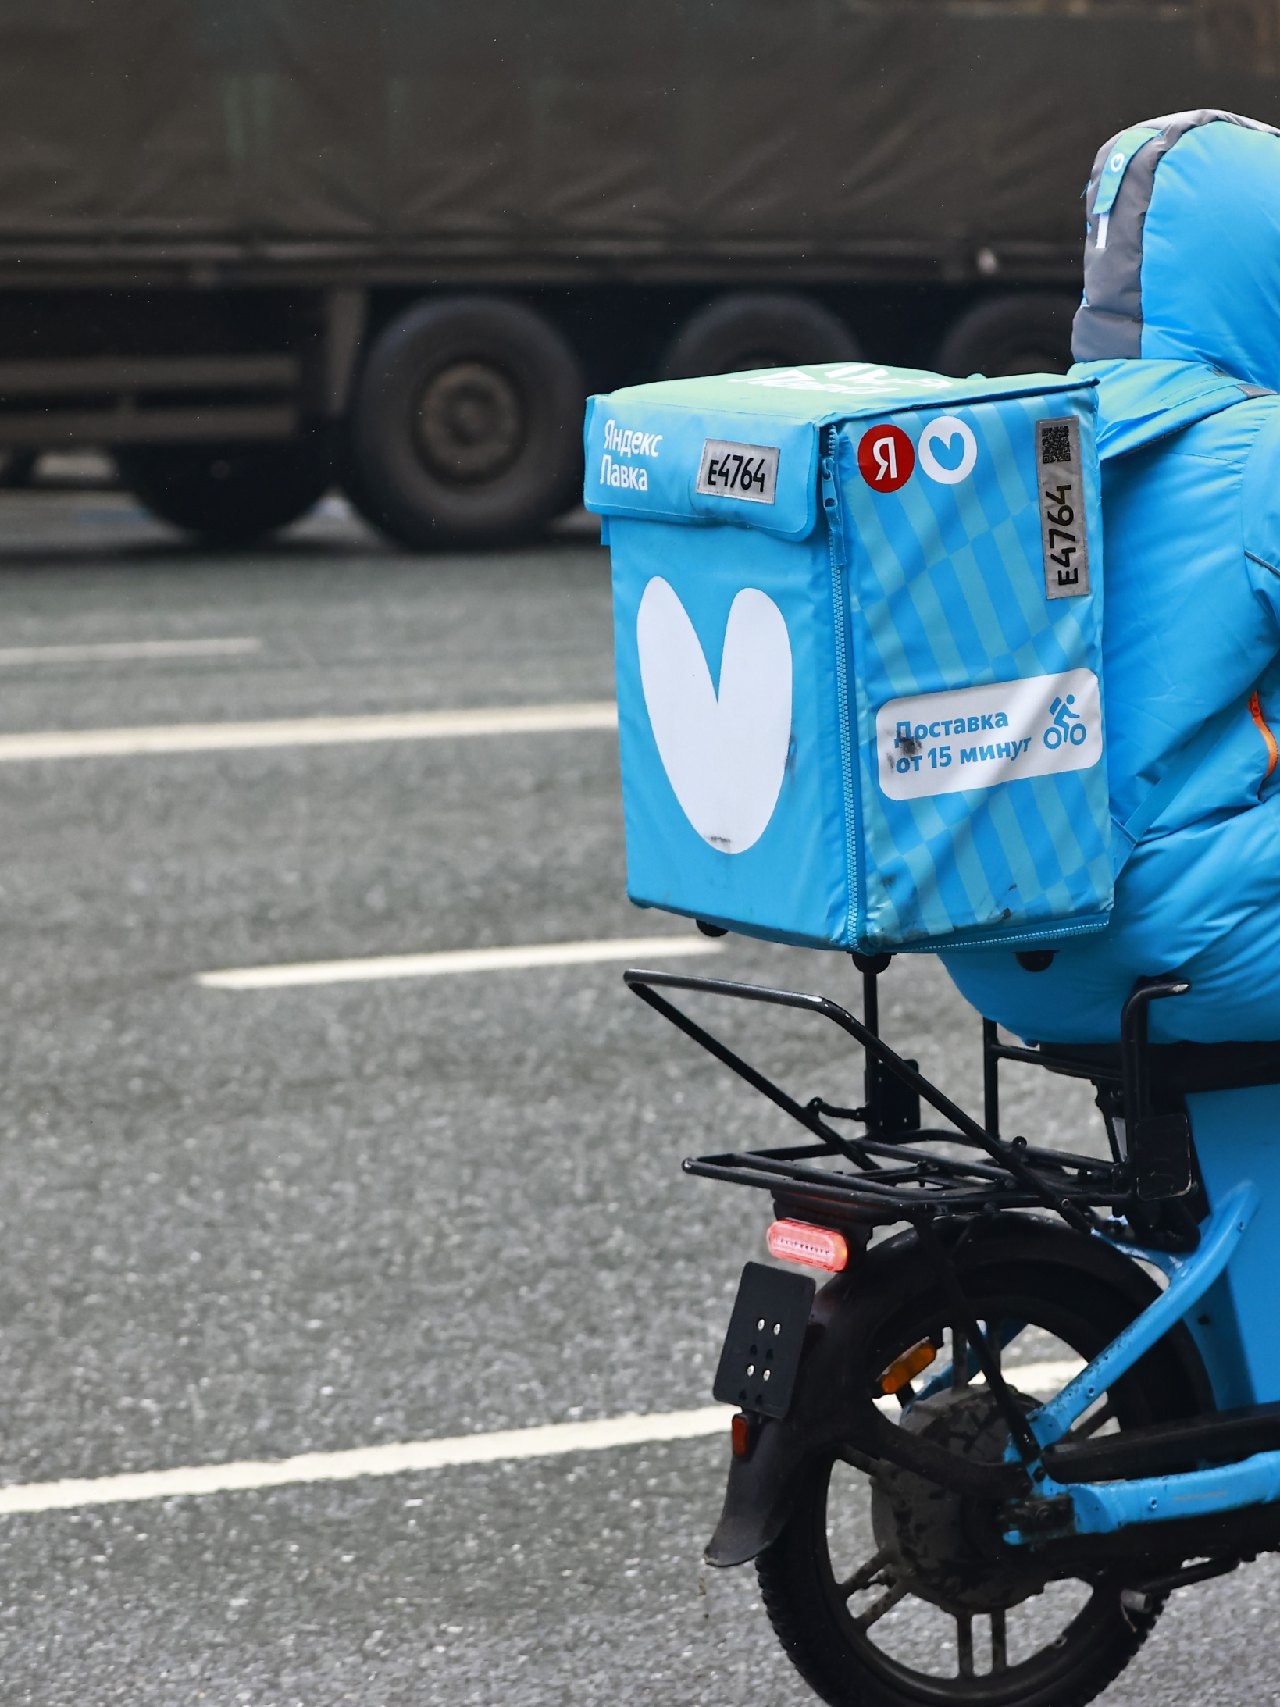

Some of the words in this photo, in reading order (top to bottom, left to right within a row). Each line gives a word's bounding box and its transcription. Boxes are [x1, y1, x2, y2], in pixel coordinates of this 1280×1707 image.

[603, 419, 663, 458] Яндекс
[600, 454, 648, 491] Лавка
[707, 454, 766, 492] E4764
[872, 437, 898, 481] Я
[1045, 485, 1079, 586] E4764
[894, 712, 1009, 748] Доставка
[896, 756, 922, 773] от
[927, 746, 952, 769] 15
[960, 737, 1032, 765] минут
